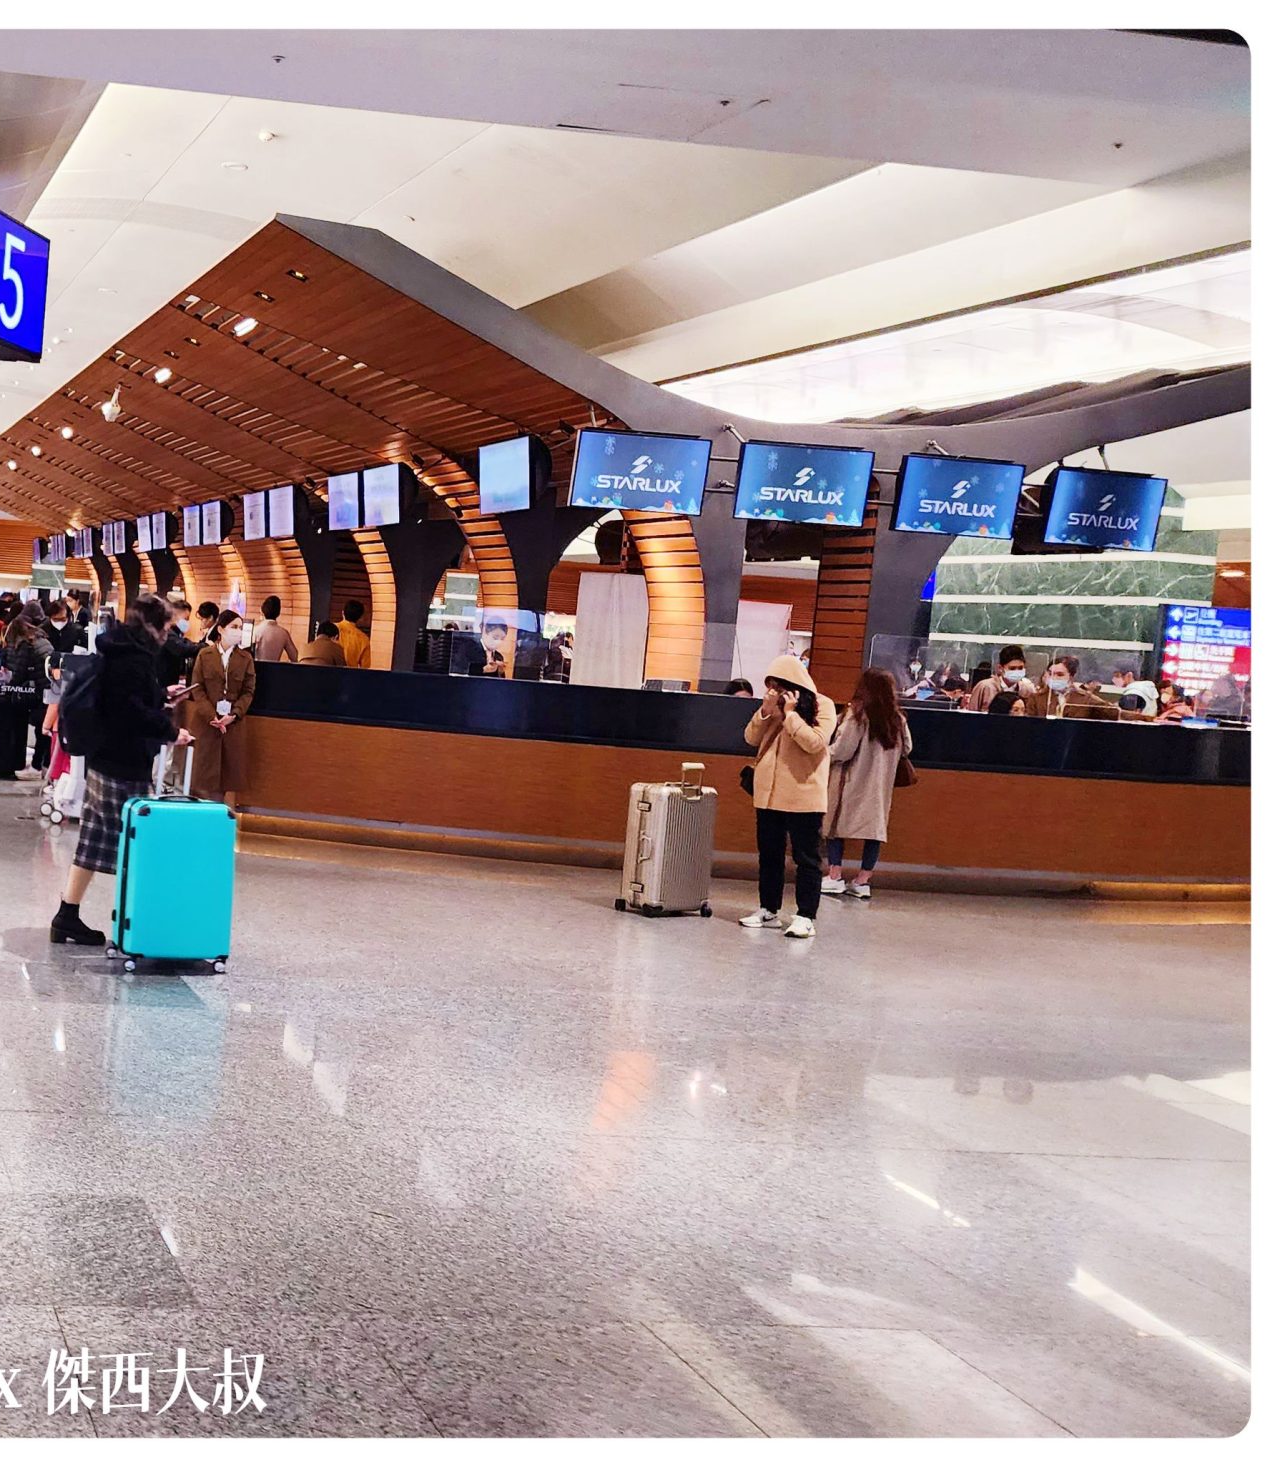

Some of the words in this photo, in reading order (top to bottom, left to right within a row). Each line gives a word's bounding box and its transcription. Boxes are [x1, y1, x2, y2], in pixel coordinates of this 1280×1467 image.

[596, 474, 682, 494] STARLUX
[759, 486, 845, 505] STARLUX
[918, 499, 997, 518] STARLUX
[1067, 512, 1140, 531] STARLUX
[1, 685, 36, 693] STARLUX
